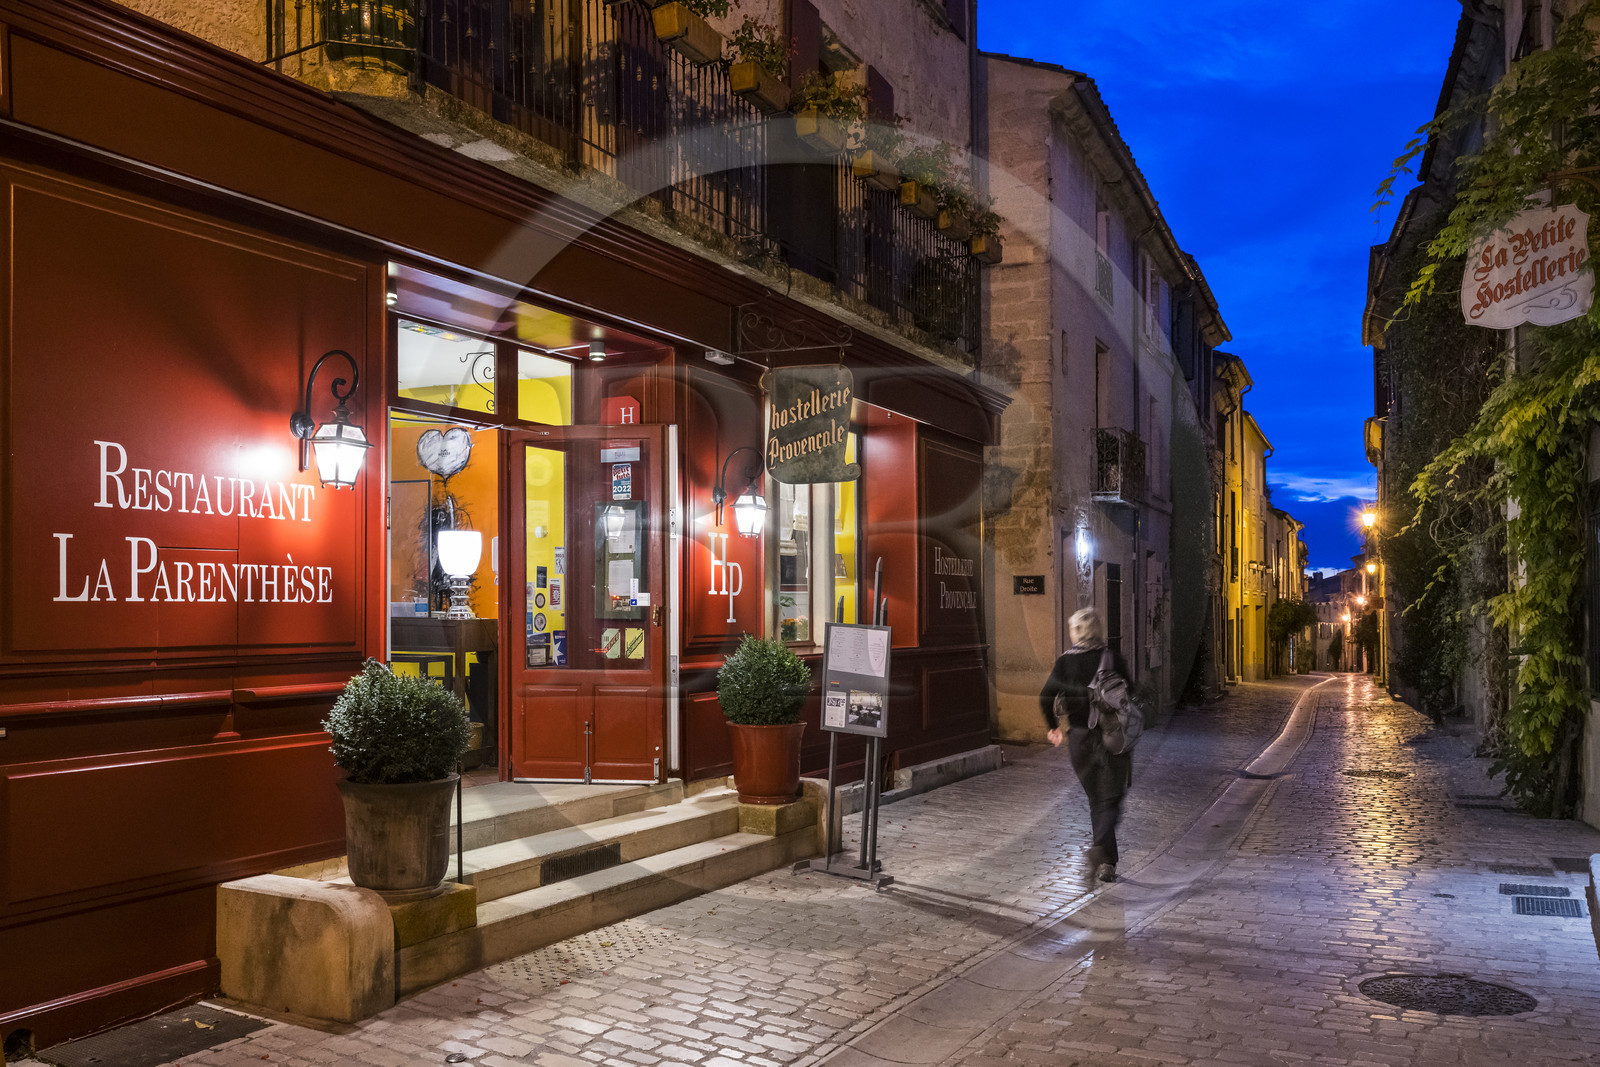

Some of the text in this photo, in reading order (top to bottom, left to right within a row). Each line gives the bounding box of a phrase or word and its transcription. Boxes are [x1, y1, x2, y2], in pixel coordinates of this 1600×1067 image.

[1473, 215, 1576, 282] La Petite
[1470, 246, 1586, 319] Hostellerie
[620, 406, 635, 424] H
[771, 381, 851, 430] hostellerie
[768, 418, 846, 470] Provençale
[93, 440, 316, 523] RESTAURANT
[613, 485, 631, 493] 2022
[125, 536, 333, 603] PARENTHÈSE
